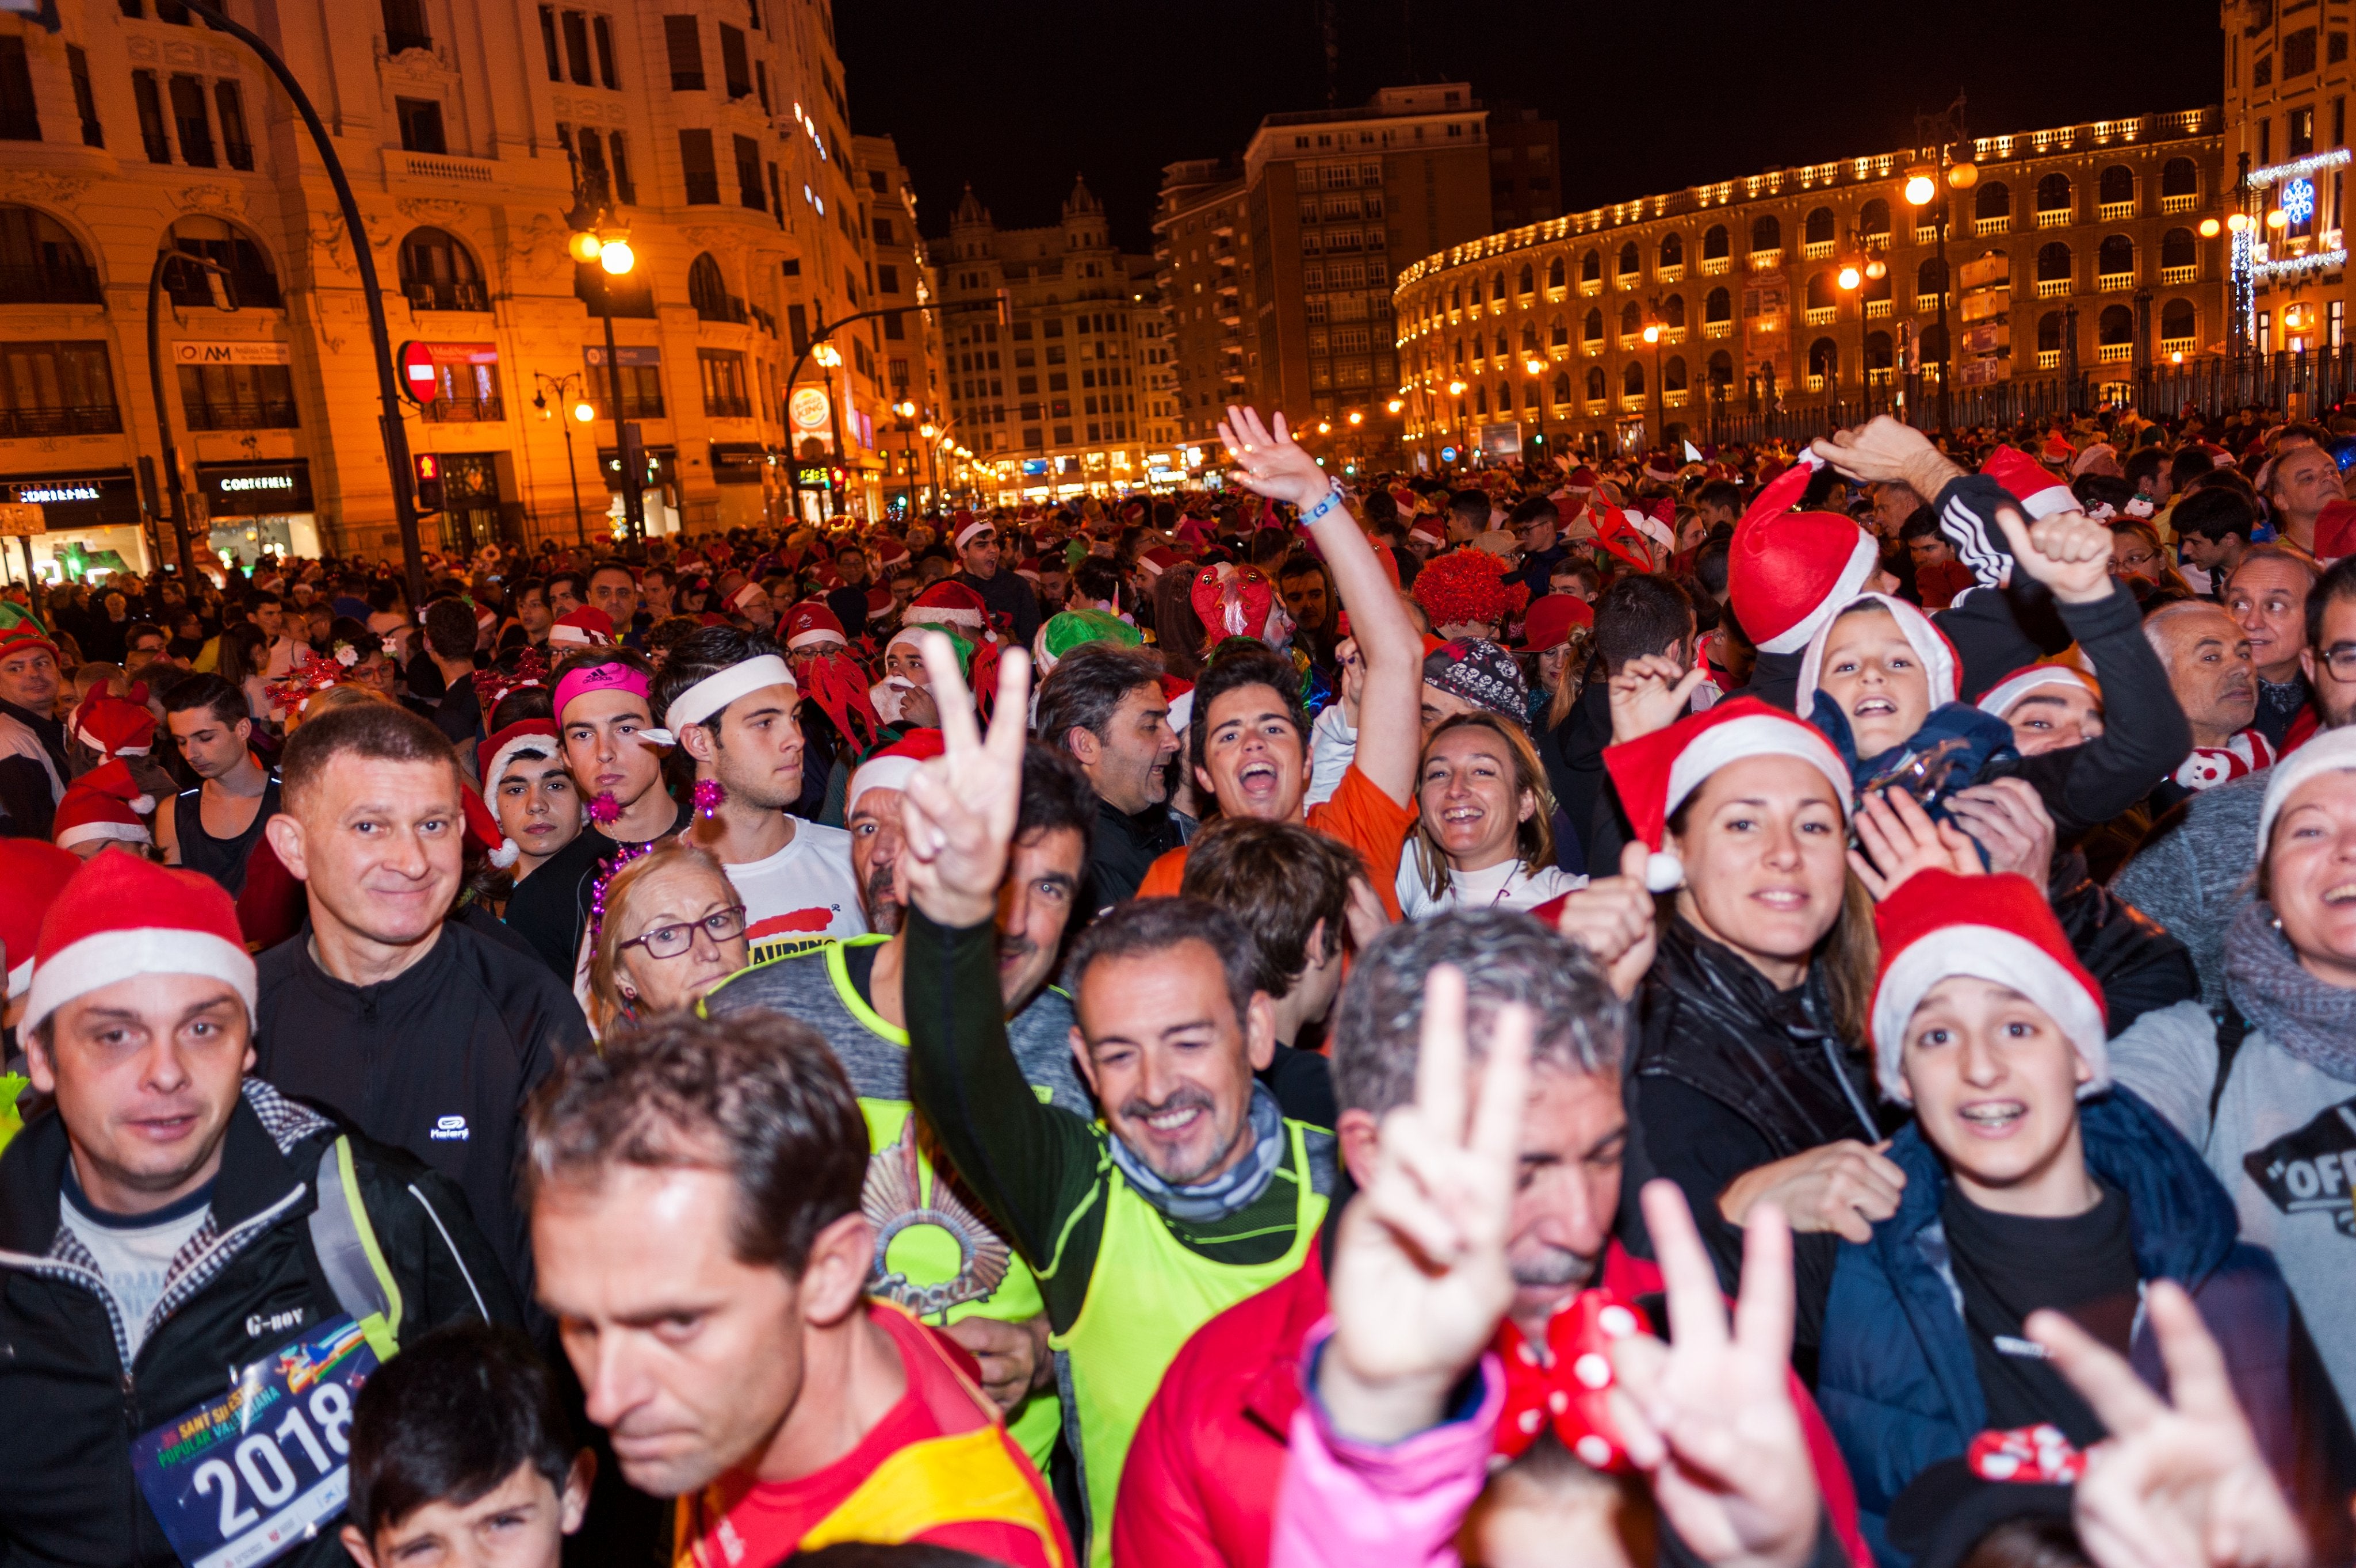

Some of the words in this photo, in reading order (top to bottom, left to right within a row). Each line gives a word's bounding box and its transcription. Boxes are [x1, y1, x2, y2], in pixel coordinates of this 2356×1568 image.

[797, 403, 823, 419] KING
[582, 676, 613, 684] adidas
[157, 1429, 212, 1469] POPULAR
[193, 1382, 353, 1540] 2018
